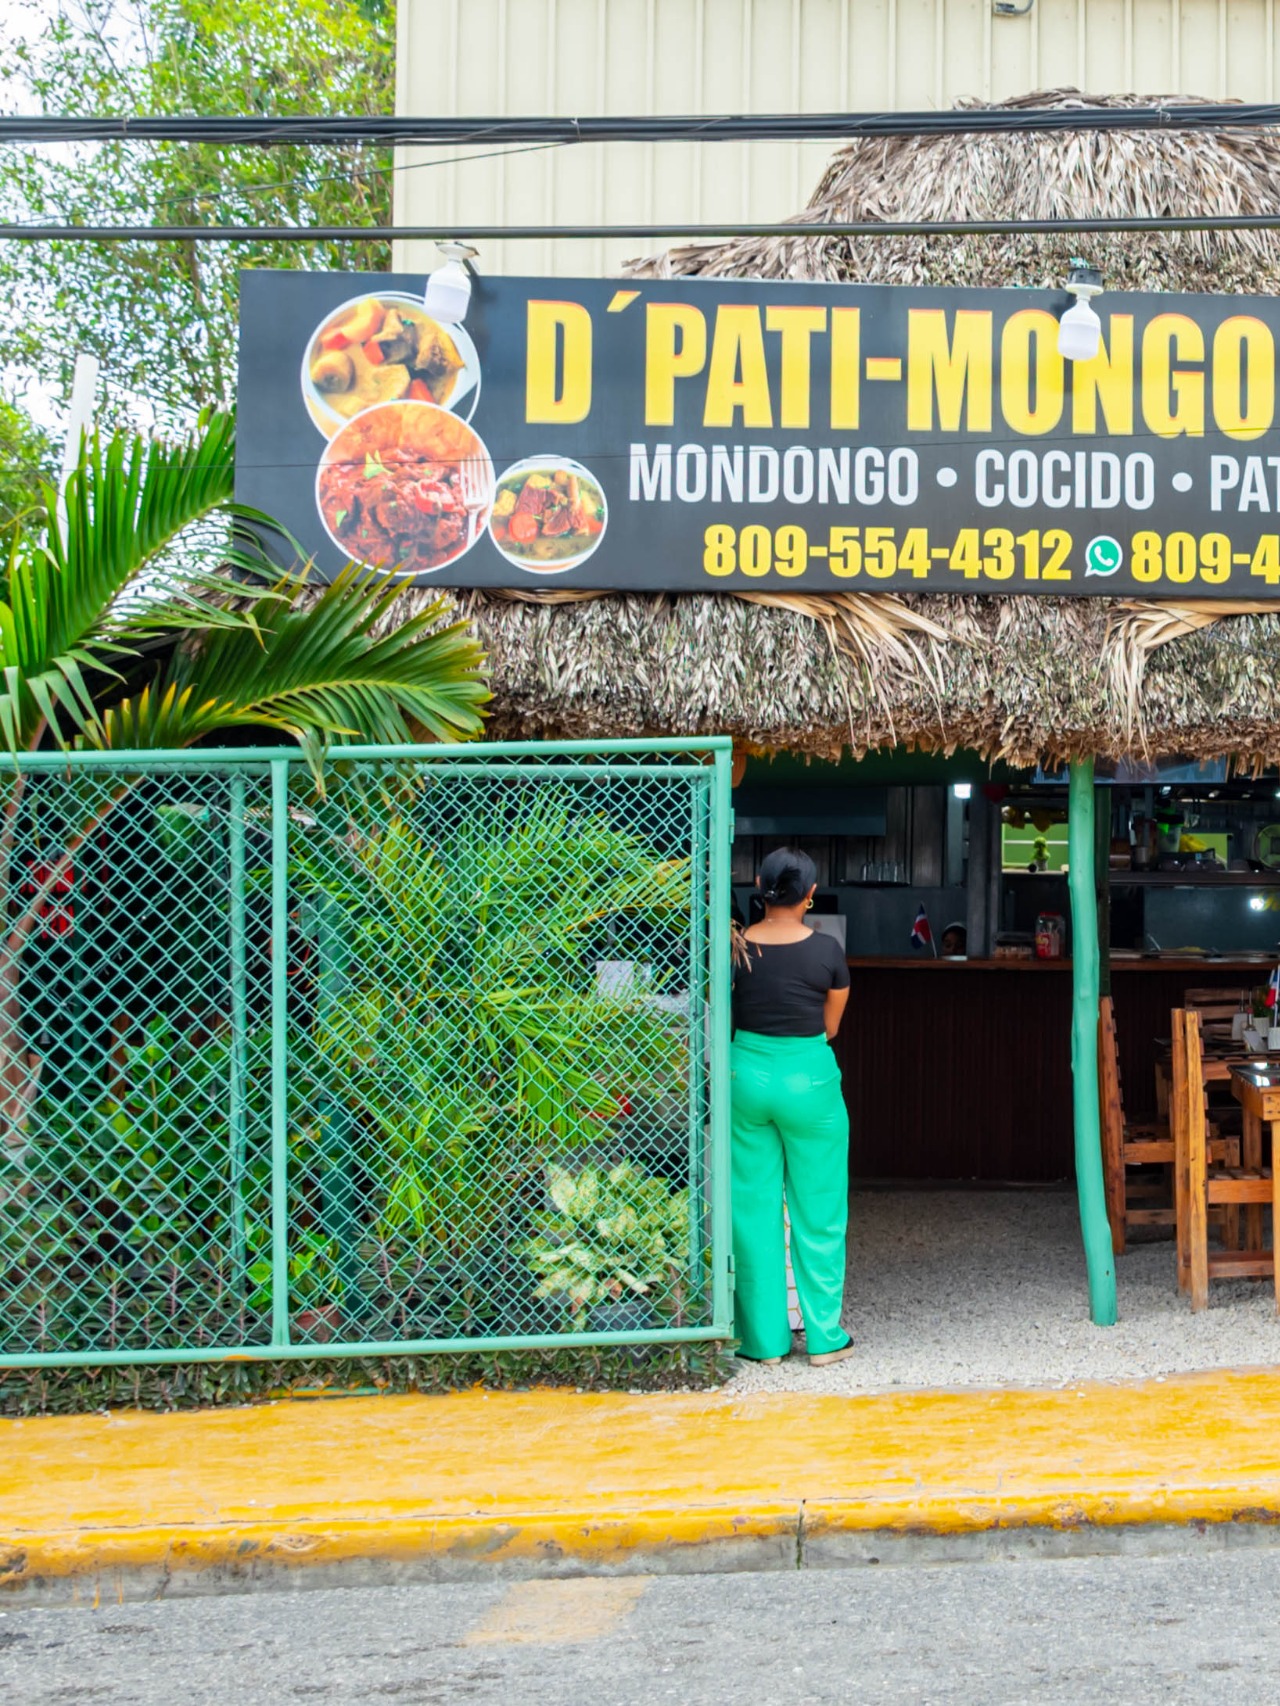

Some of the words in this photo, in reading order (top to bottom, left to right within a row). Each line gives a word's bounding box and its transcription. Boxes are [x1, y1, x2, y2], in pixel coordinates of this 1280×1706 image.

[629, 443, 919, 506] MONDONGO
[975, 448, 1155, 511] COCIDO
[702, 524, 1073, 581] 809-554-4312
